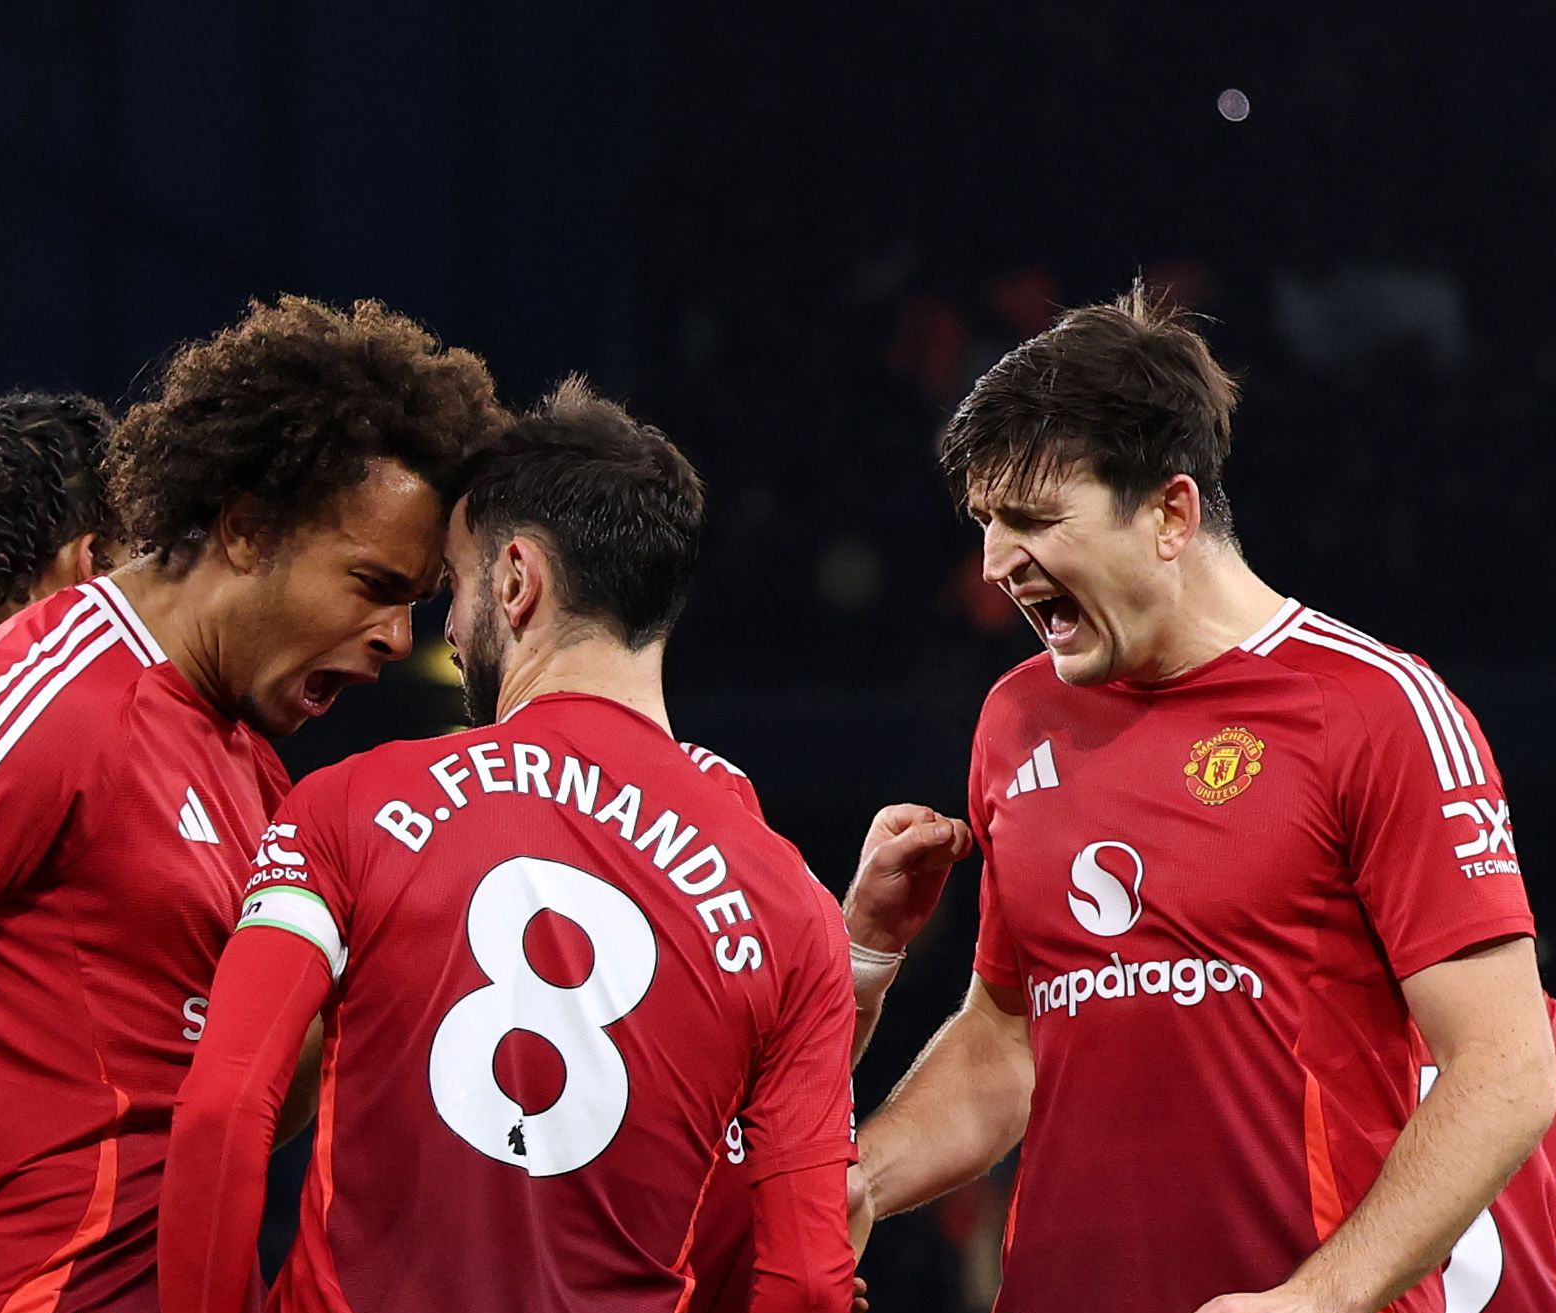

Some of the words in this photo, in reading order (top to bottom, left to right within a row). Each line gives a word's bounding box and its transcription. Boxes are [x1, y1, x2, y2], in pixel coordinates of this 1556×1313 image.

[1196, 732, 1259, 757] MANCHESTER
[1195, 785, 1238, 799] UNITED
[1441, 798, 1516, 859] DX
[373, 741, 763, 974] B.FERNANDES
[1460, 859, 1522, 879] TECHNO
[427, 855, 659, 1178] 8
